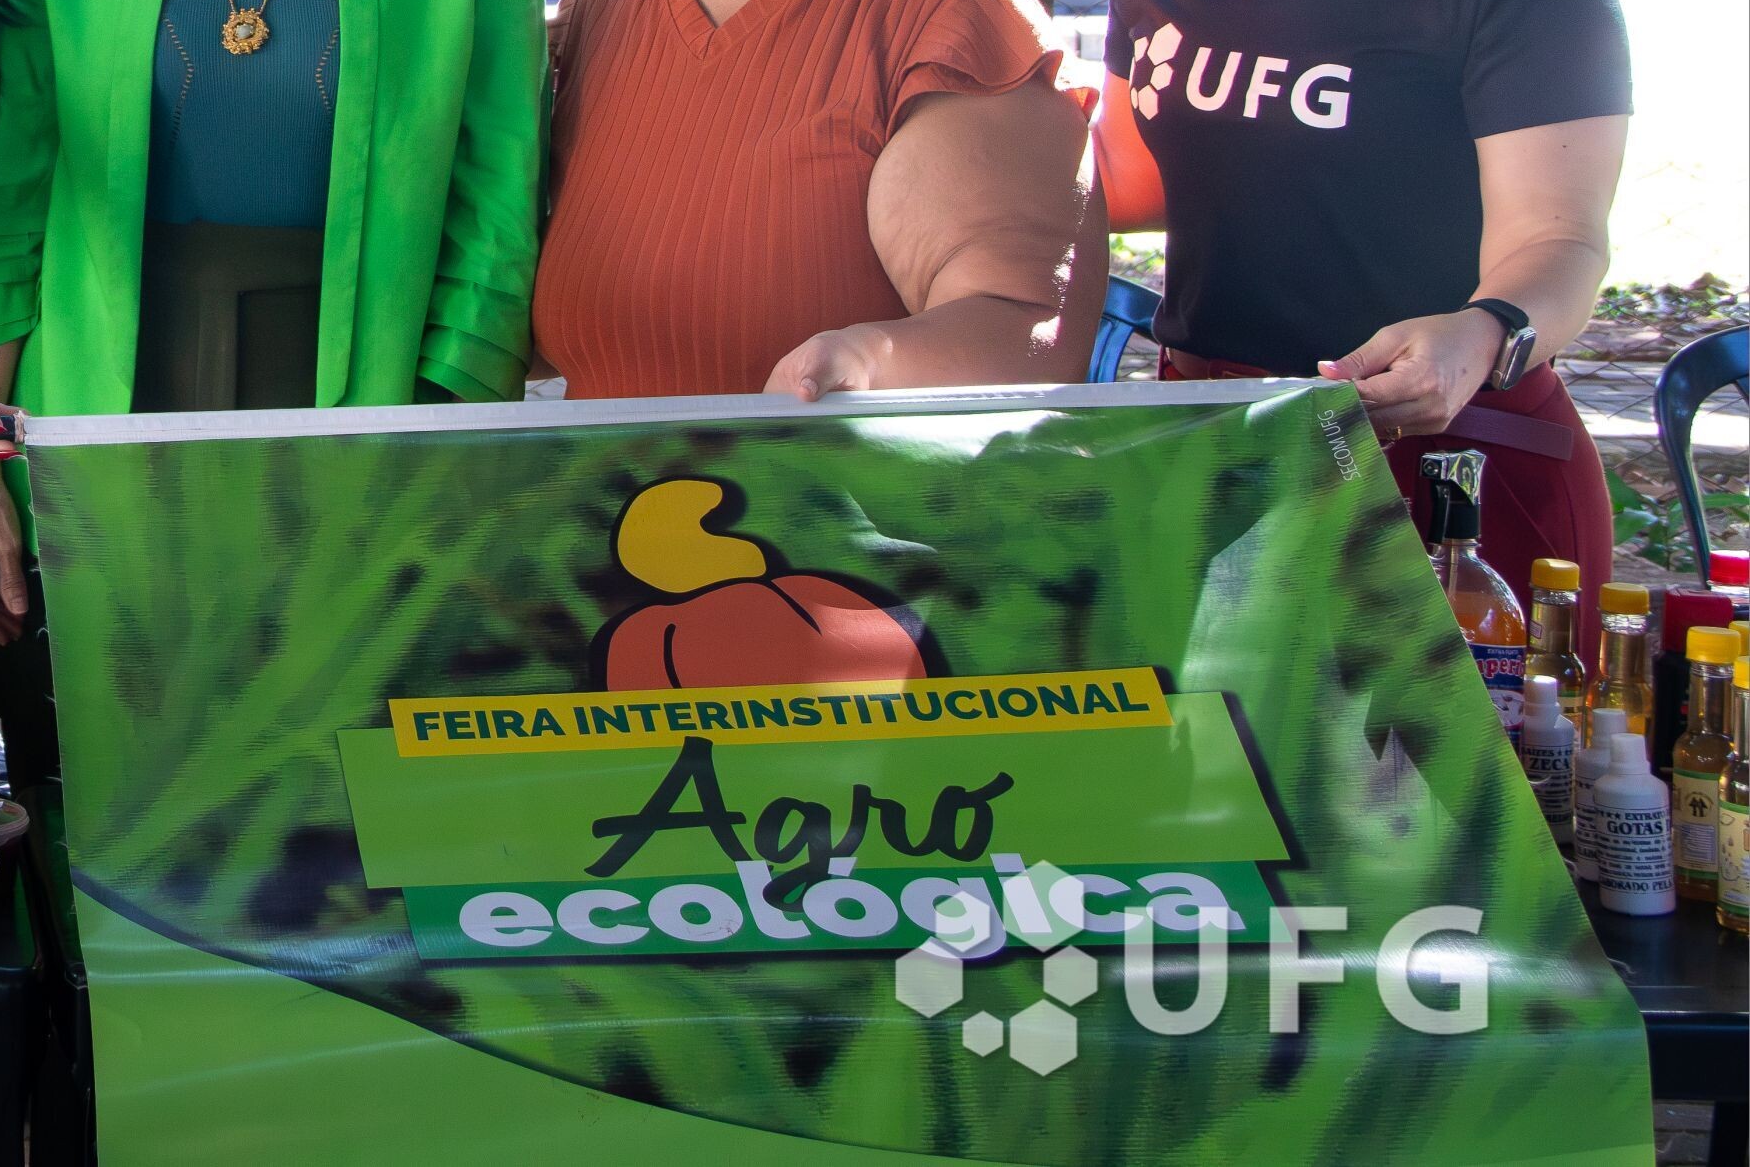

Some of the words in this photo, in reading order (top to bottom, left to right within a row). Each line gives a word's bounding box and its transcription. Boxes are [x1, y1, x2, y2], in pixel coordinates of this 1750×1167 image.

[1185, 46, 1352, 129] UFG
[1317, 409, 1341, 437] UFG
[1328, 436, 1361, 481] SECOM
[412, 708, 566, 741] FEIRA
[572, 681, 1150, 735] INTERINSTITUCIONAL
[583, 735, 1015, 913] Agro
[1606, 819, 1664, 835] GOTAS
[458, 852, 1247, 960] ecológica
